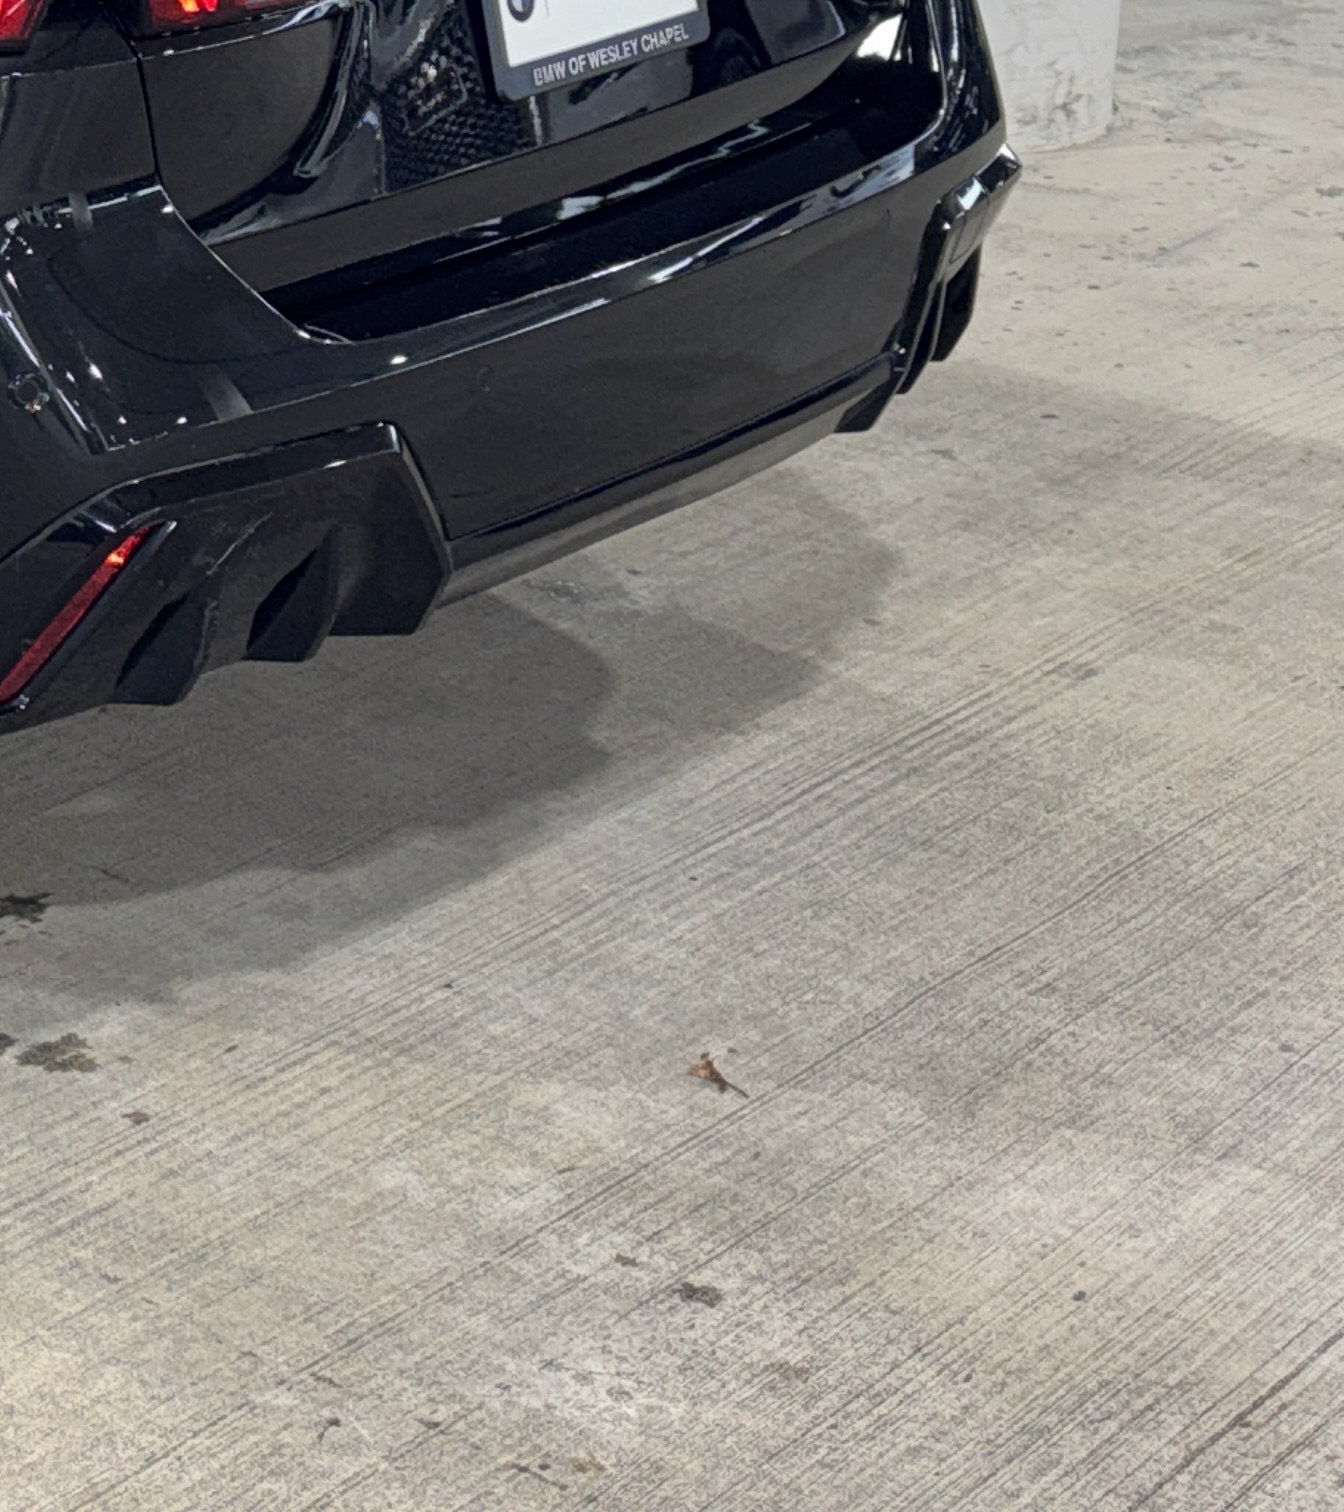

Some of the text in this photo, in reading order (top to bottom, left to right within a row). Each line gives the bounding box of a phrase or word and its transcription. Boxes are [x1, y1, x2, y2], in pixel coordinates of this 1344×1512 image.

[533, 24, 689, 86] BMW OF WESLEY CHAPEL
